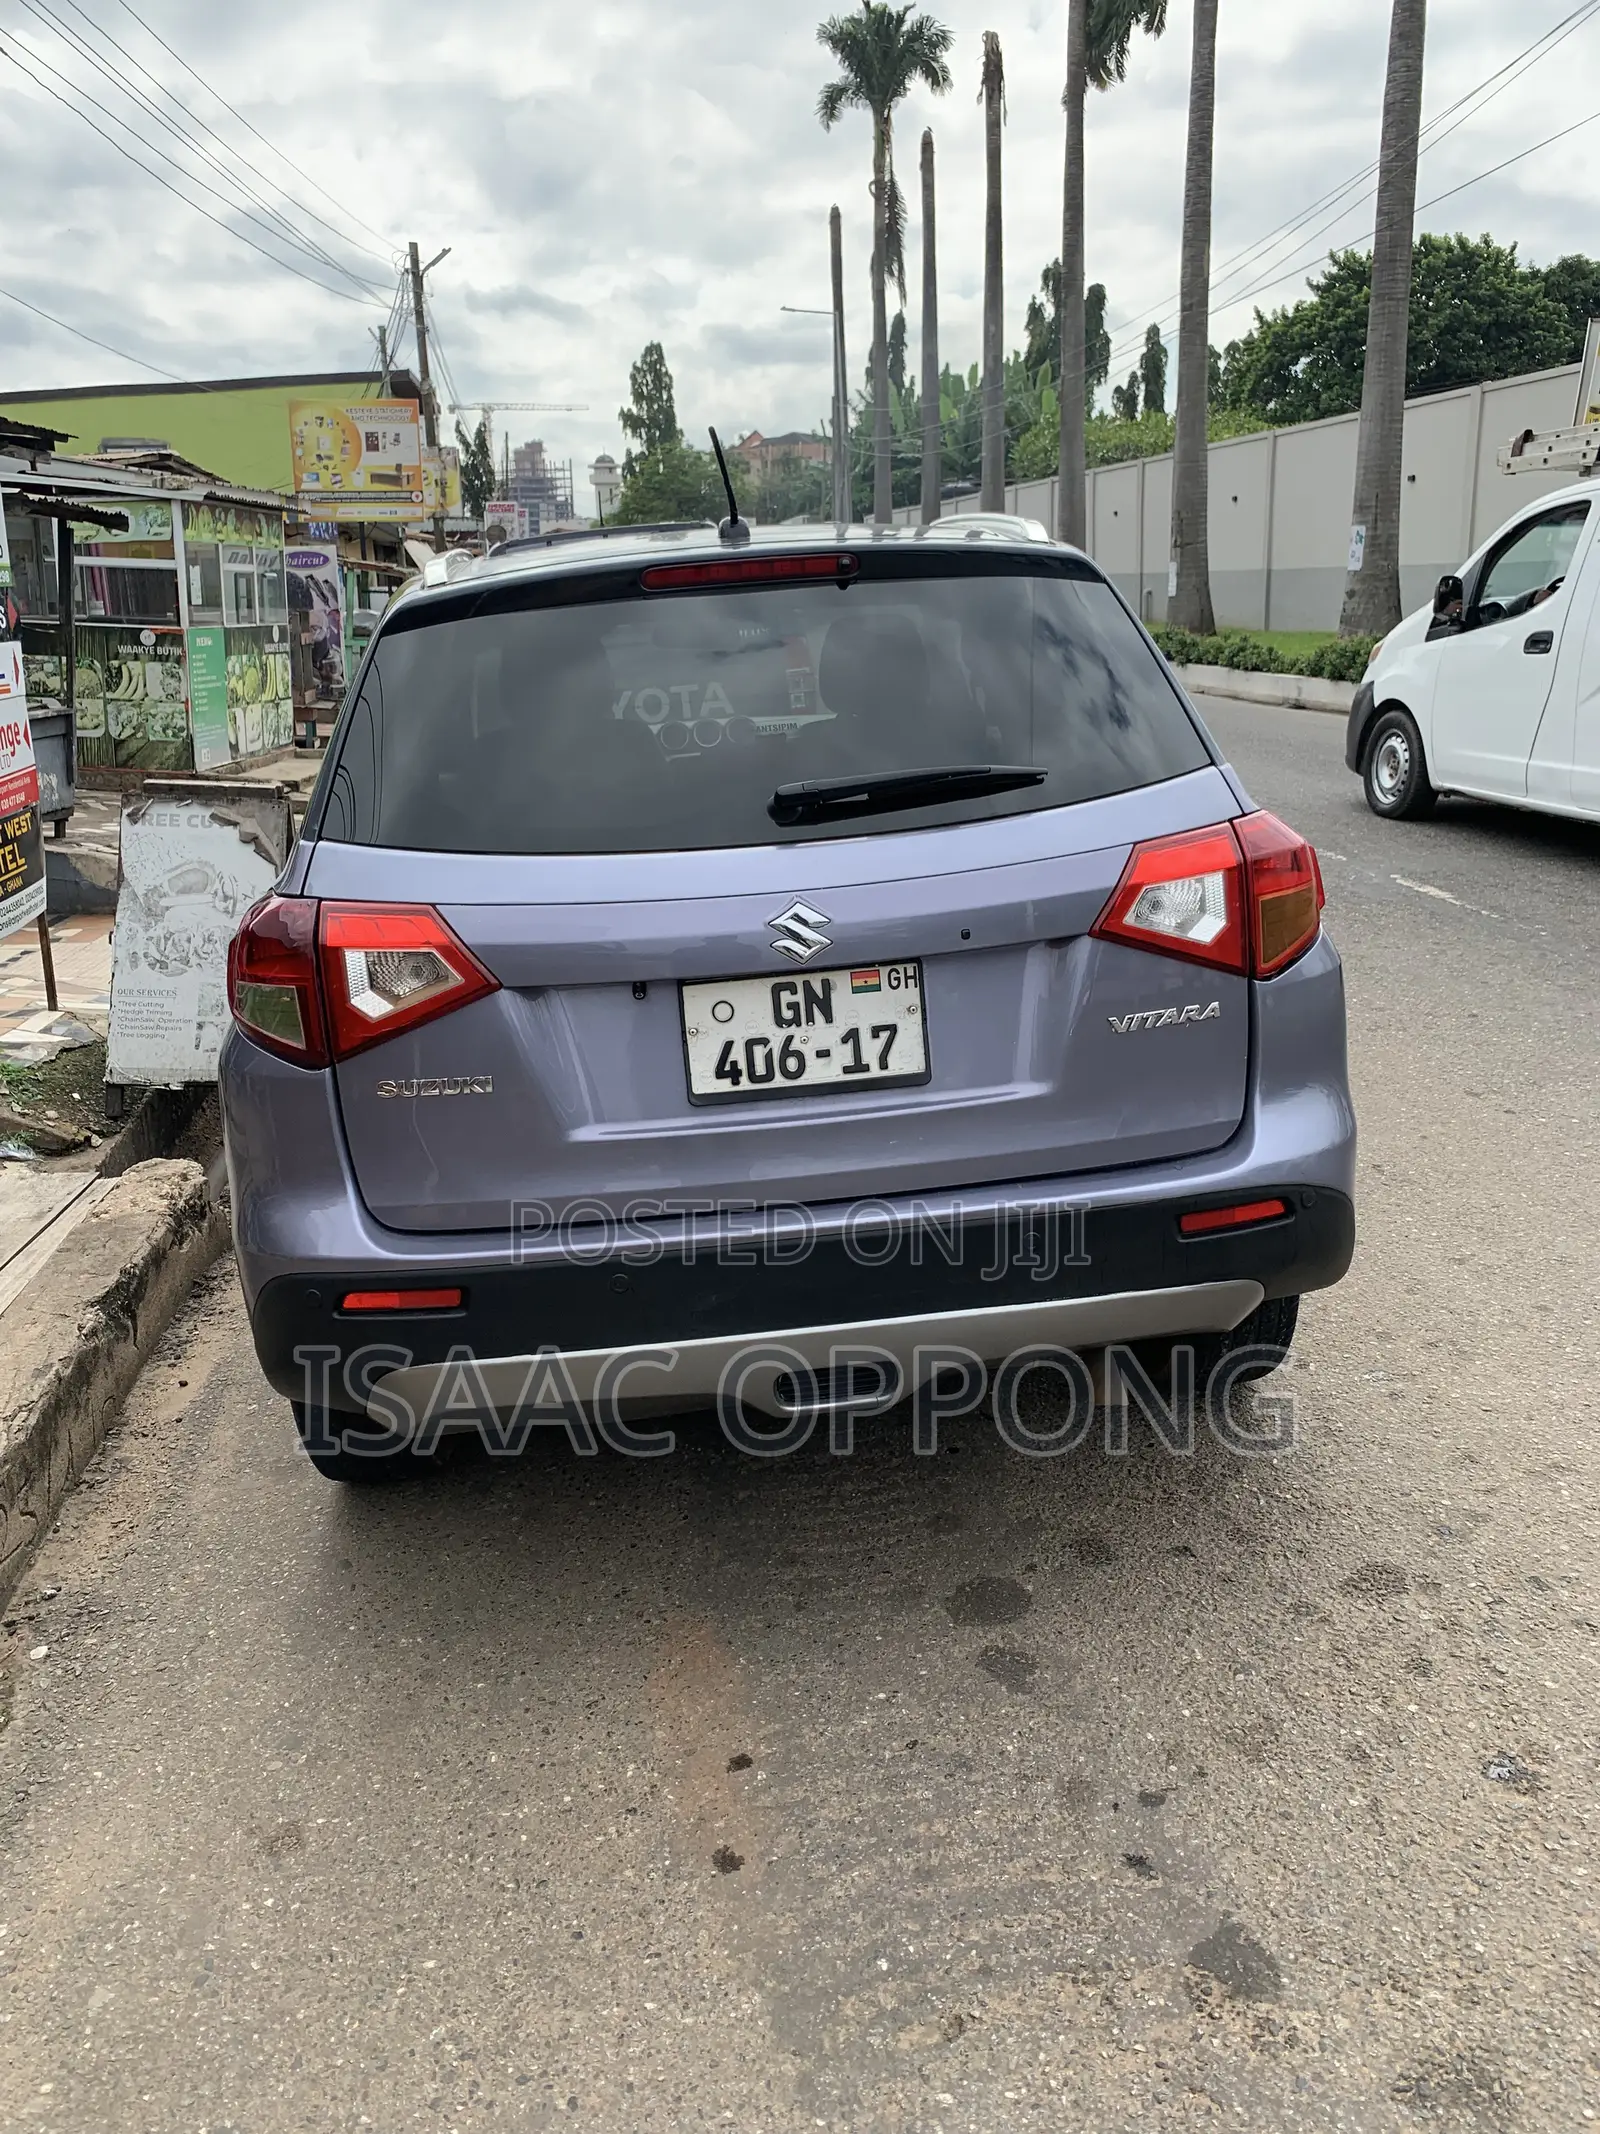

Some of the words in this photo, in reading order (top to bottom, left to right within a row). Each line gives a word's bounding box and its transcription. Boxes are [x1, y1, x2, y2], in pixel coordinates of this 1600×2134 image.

[285, 552, 324, 566] haircut
[117, 645, 155, 655] WAAKYE
[157, 646, 183, 656] BUTIK
[4, 812, 31, 840] WEST
[136, 813, 180, 828] REE
[887, 966, 918, 990] GH
[117, 988, 135, 996] OUR
[136, 988, 177, 997] SERVICES
[771, 978, 833, 1028] GN
[138, 1001, 165, 1009] Cutting
[1108, 1001, 1221, 1033] VITARA
[714, 1024, 897, 1086] 406-17
[377, 1076, 493, 1099] SUZUKI
